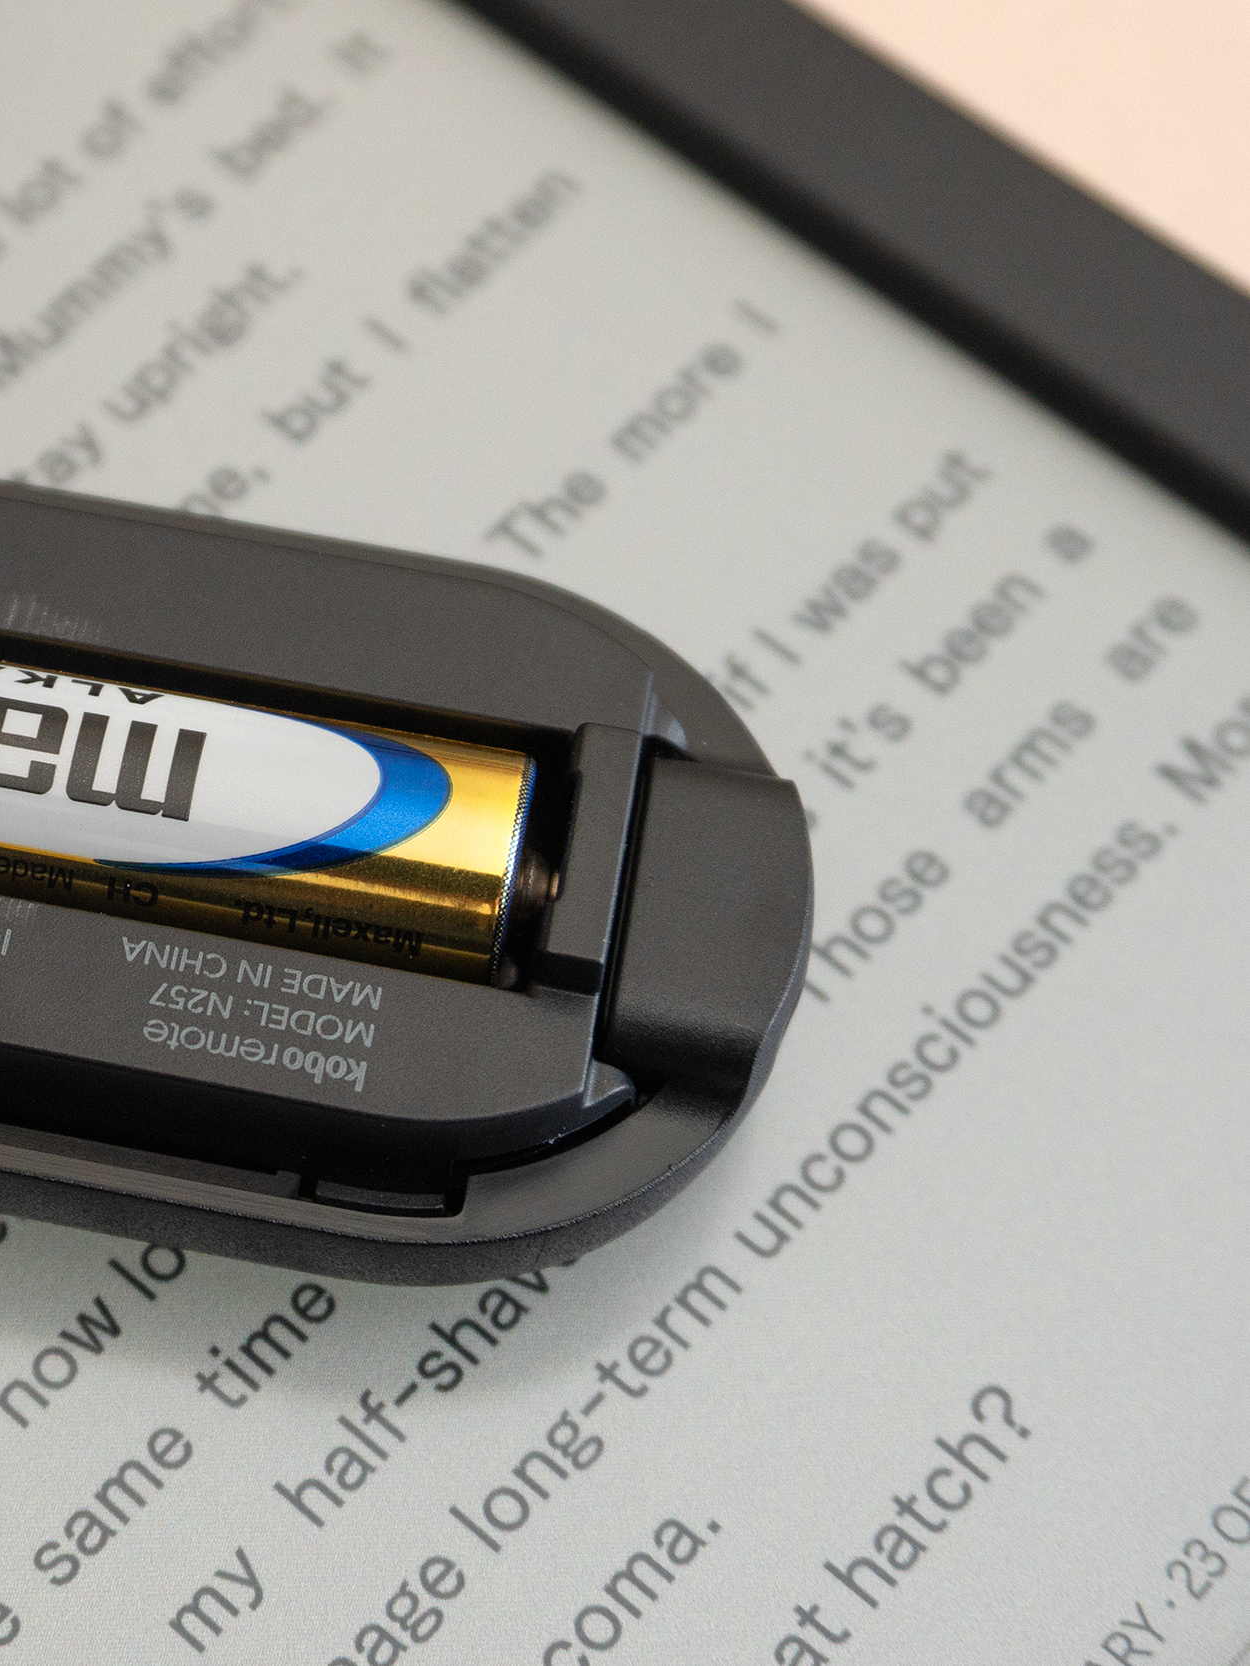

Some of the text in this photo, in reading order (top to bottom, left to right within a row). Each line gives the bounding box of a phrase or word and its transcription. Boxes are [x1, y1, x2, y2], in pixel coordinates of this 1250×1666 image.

[79, 98, 146, 160] of
[12, 258, 308, 487] ay upright.
[258, 354, 374, 449] but
[358, 312, 412, 356] I
[405, 170, 587, 317] flatten
[481, 298, 784, 561] The more I
[750, 625, 802, 666] I
[790, 536, 904, 636] was
[893, 446, 996, 545] put
[801, 523, 1096, 792] it's been a
[962, 700, 1097, 830] arms
[1104, 596, 1201, 685] are
[121, 936, 384, 1011] MADE IN CHINA
[148, 981, 376, 1049] MODEL: N257
[327, 1554, 467, 1666] age
[449, 1263, 744, 1553] long-term
[733, 819, 1181, 1261] unconsciousness.
[31, 1426, 194, 1588] same
[194, 1277, 338, 1410] time
[823, 1383, 1032, 1609] hatch?
[167, 1547, 266, 1655] my
[543, 1516, 724, 1666] coma.
[1164, 1537, 1229, 1602] 23
